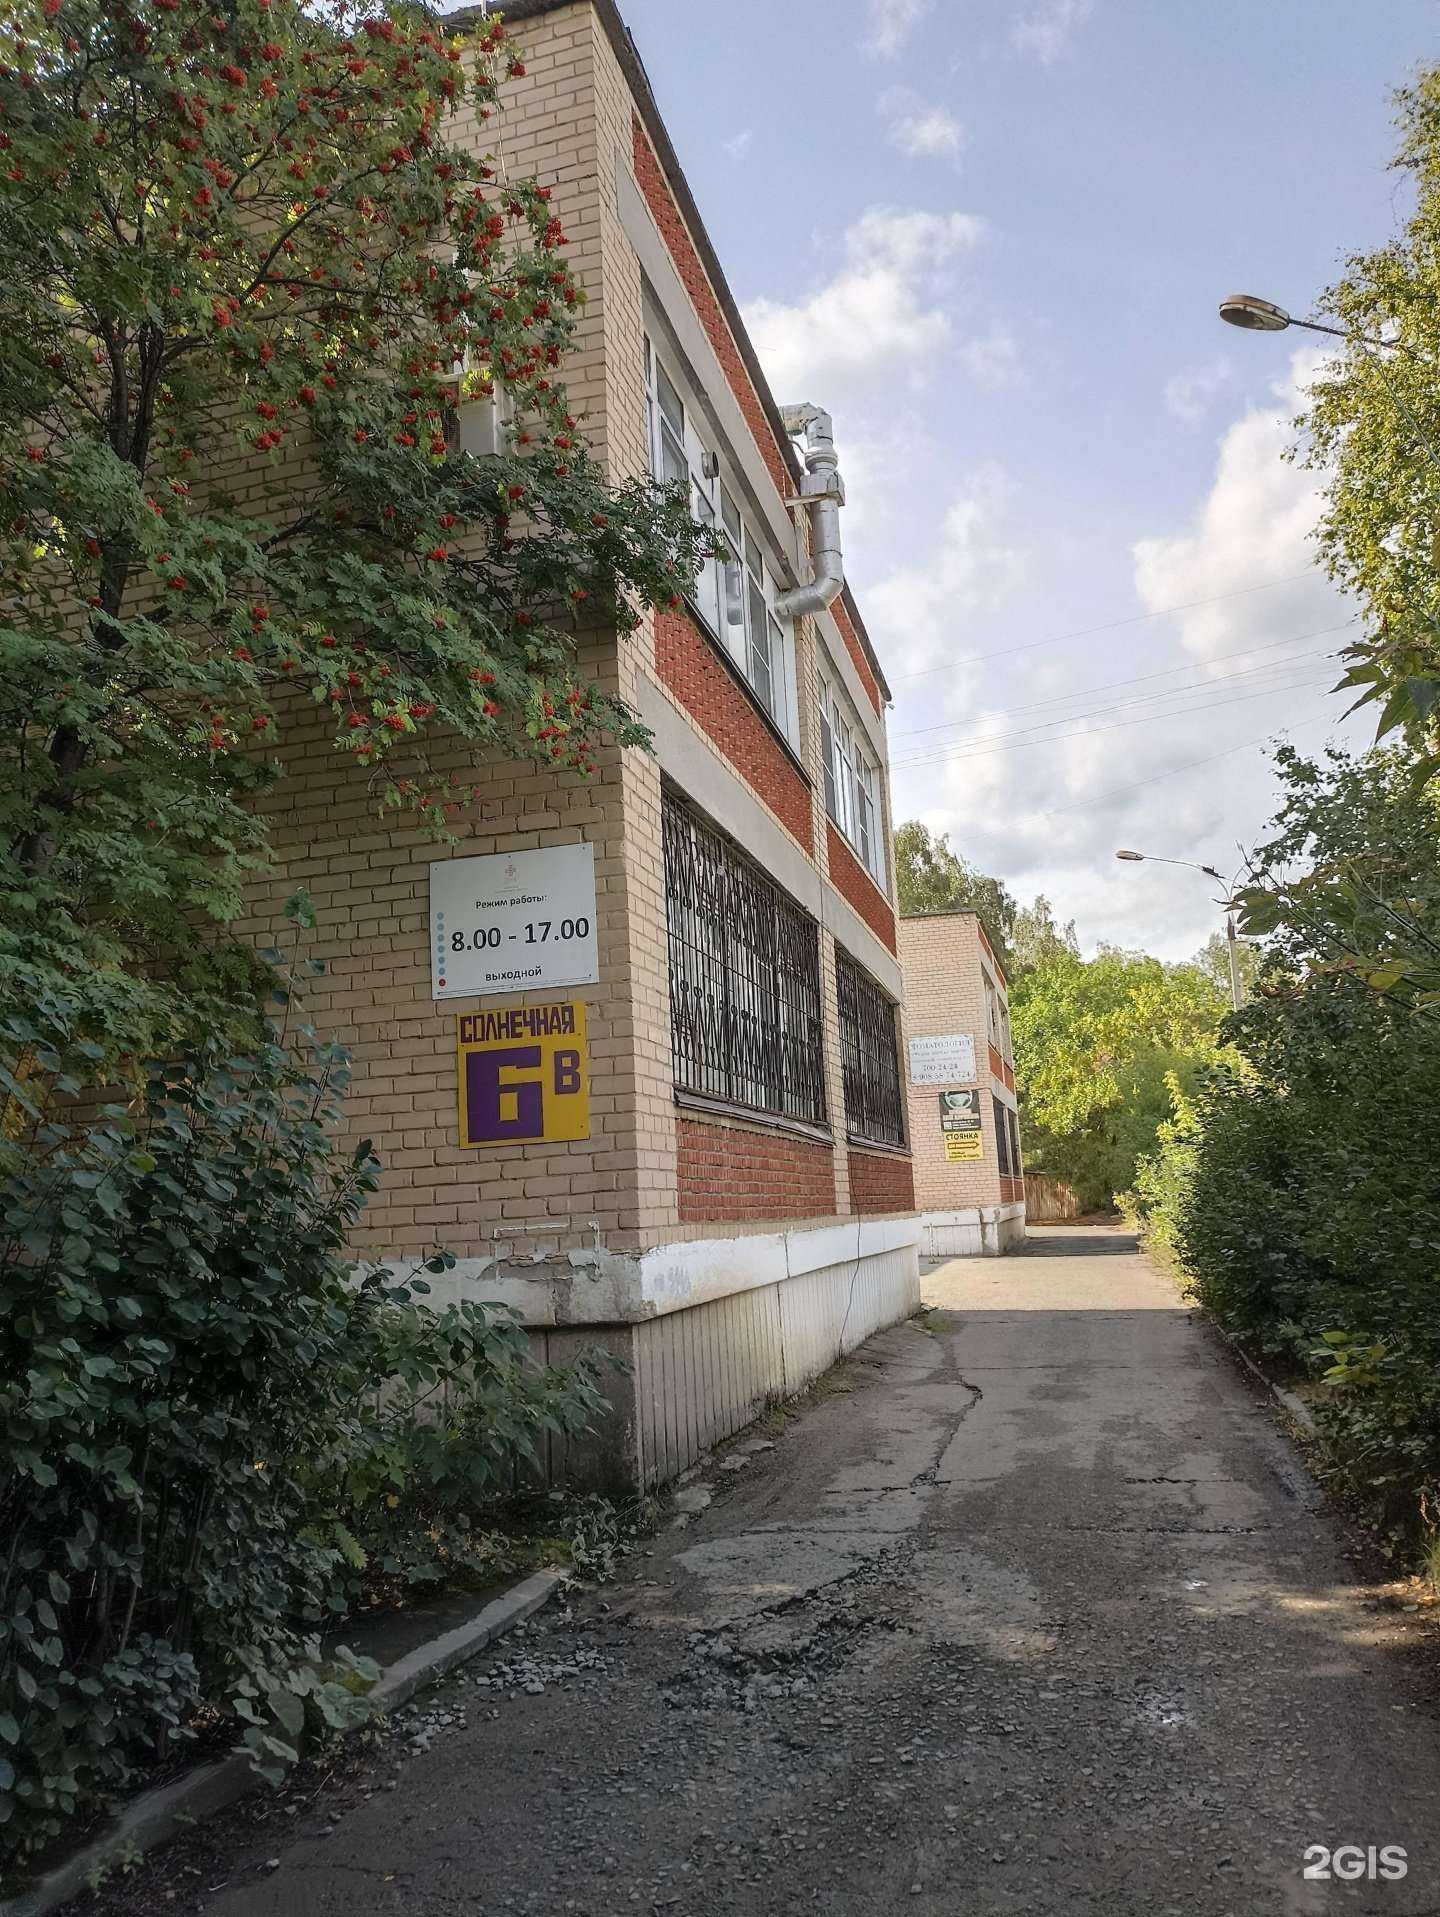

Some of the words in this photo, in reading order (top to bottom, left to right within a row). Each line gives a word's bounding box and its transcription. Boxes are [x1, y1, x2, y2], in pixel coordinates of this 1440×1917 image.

[475, 898, 508, 910] Режим
[510, 894, 548, 907] работы:
[451, 927, 501, 952] 8.00
[524, 917, 590, 944] 17.00
[485, 965, 542, 982] выходной
[460, 1005, 575, 1043] СОЛНЕЧНАЯ
[946, 1132, 979, 1141] СТОЯНКА
